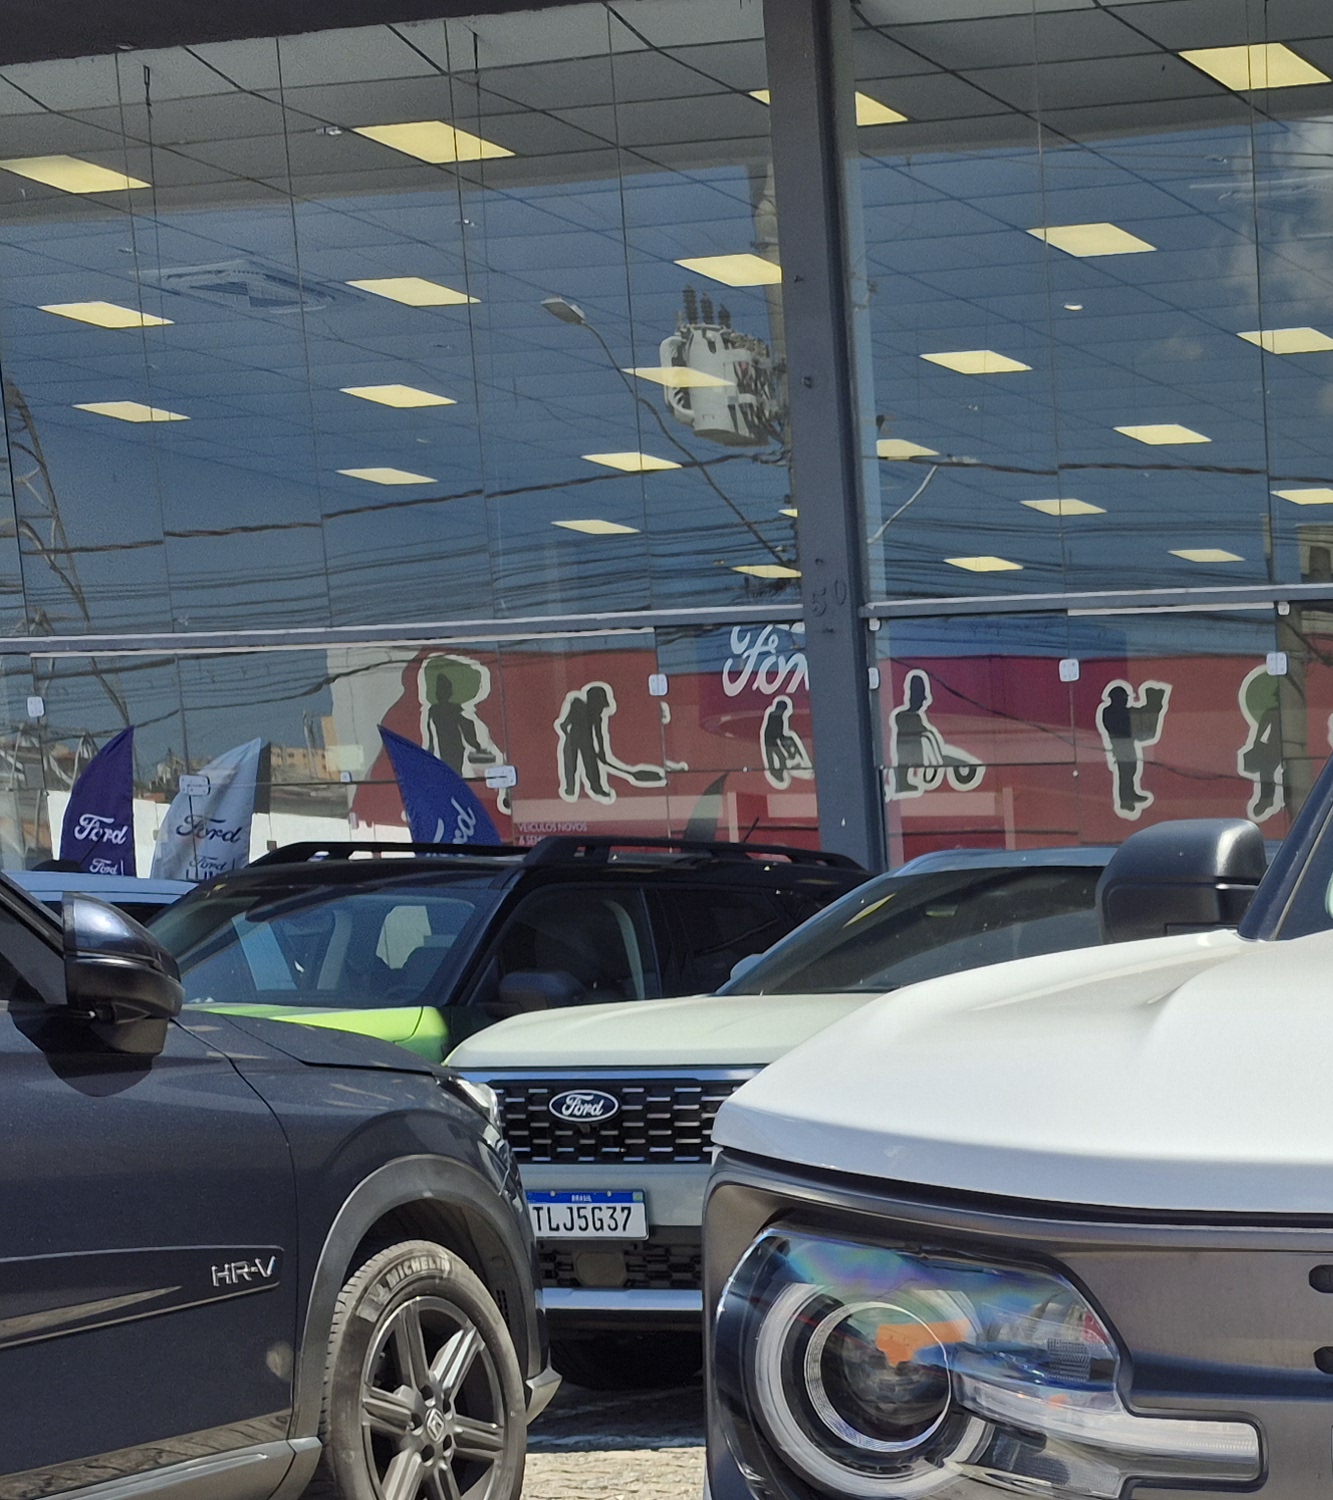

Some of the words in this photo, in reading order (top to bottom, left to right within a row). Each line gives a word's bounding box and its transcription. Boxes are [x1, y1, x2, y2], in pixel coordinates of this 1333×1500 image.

[74, 813, 128, 845] Ford
[176, 814, 242, 843] Ford
[557, 821, 588, 832] NOVOS
[89, 857, 118, 875] Ford
[189, 854, 227, 871] Ford
[561, 1094, 605, 1117] Ford
[532, 1206, 632, 1232] TLJ5G37
[211, 1255, 277, 1287] HR-V
[385, 1256, 451, 1289] MICHELIN
